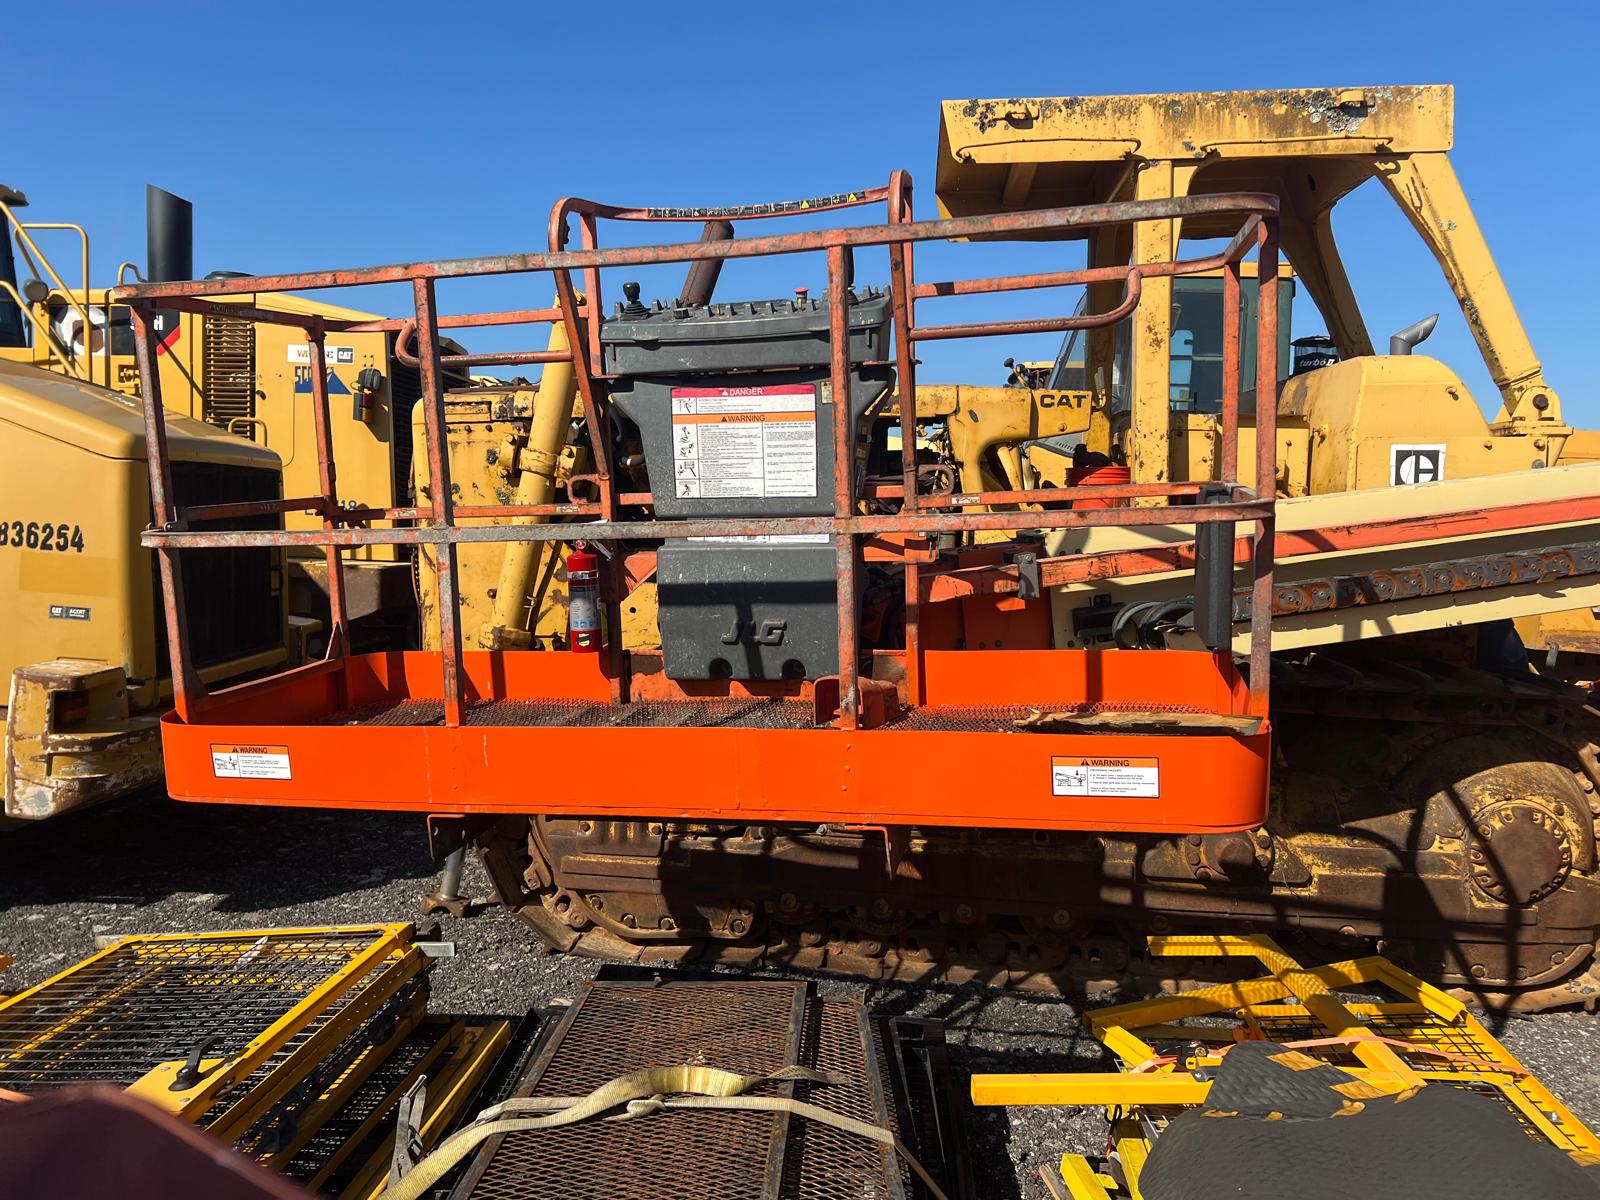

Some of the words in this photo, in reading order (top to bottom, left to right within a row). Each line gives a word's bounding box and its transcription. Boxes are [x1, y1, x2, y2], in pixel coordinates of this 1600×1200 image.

[729, 387, 764, 396] DANGER
[1040, 394, 1087, 409] CAT
[727, 414, 766, 423] WARNING
[720, 618, 788, 646] JLG
[239, 746, 268, 754] WARNING
[1091, 759, 1130, 767] WARNING
